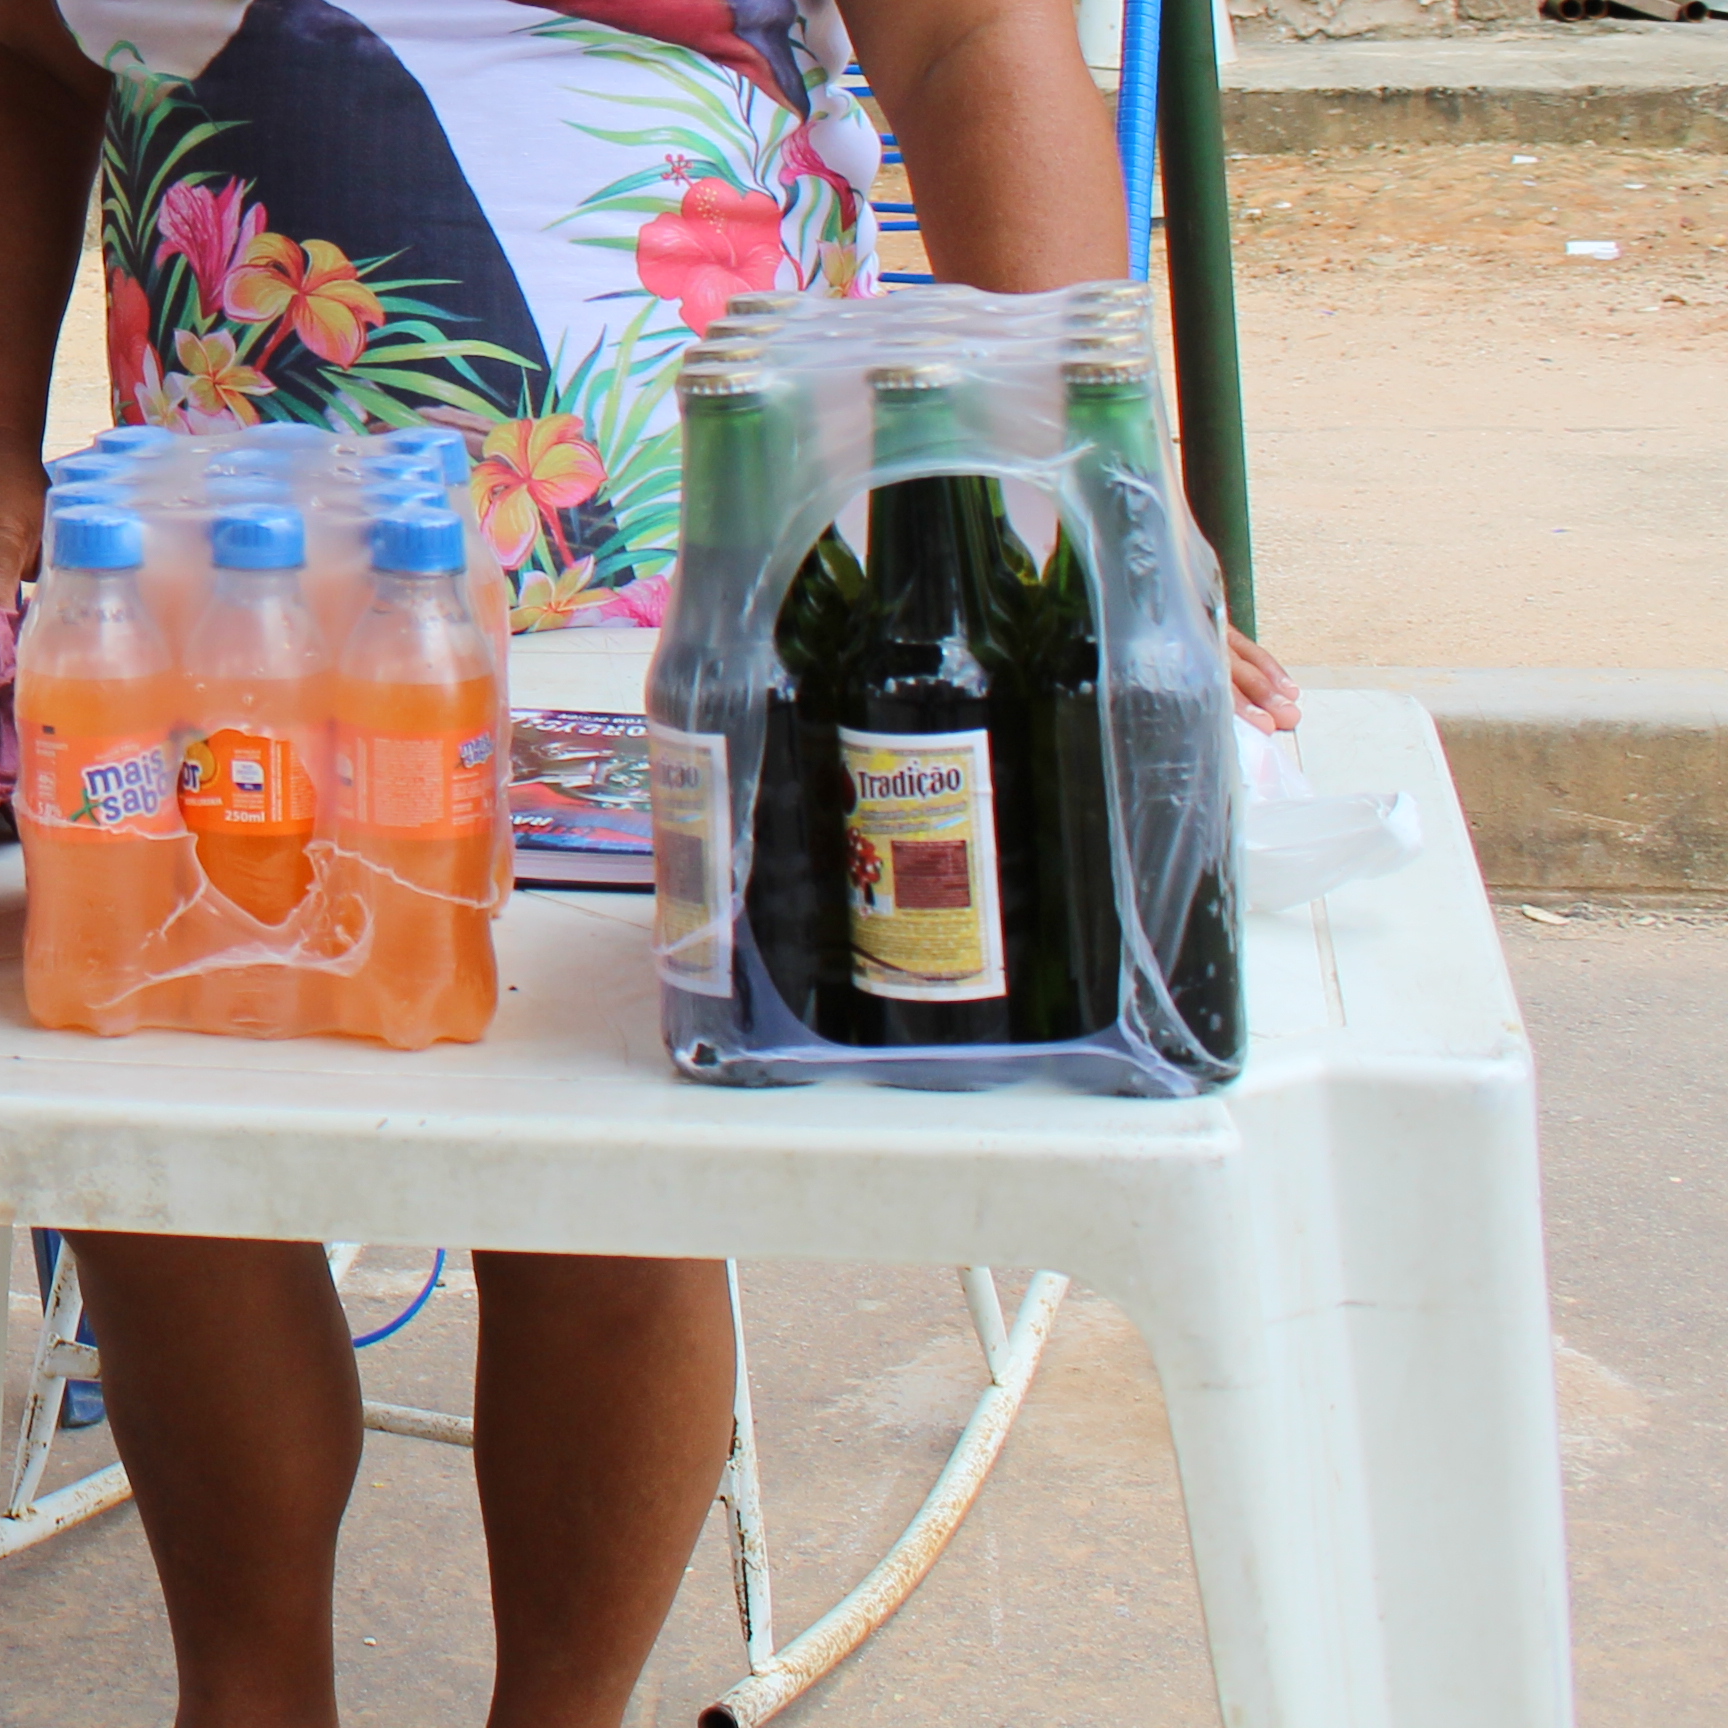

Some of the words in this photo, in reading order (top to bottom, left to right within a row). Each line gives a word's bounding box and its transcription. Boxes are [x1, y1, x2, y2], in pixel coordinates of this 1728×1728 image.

[83, 749, 165, 799] mais
[856, 760, 962, 800] Tradição
[225, 809, 266, 823] 250ml
